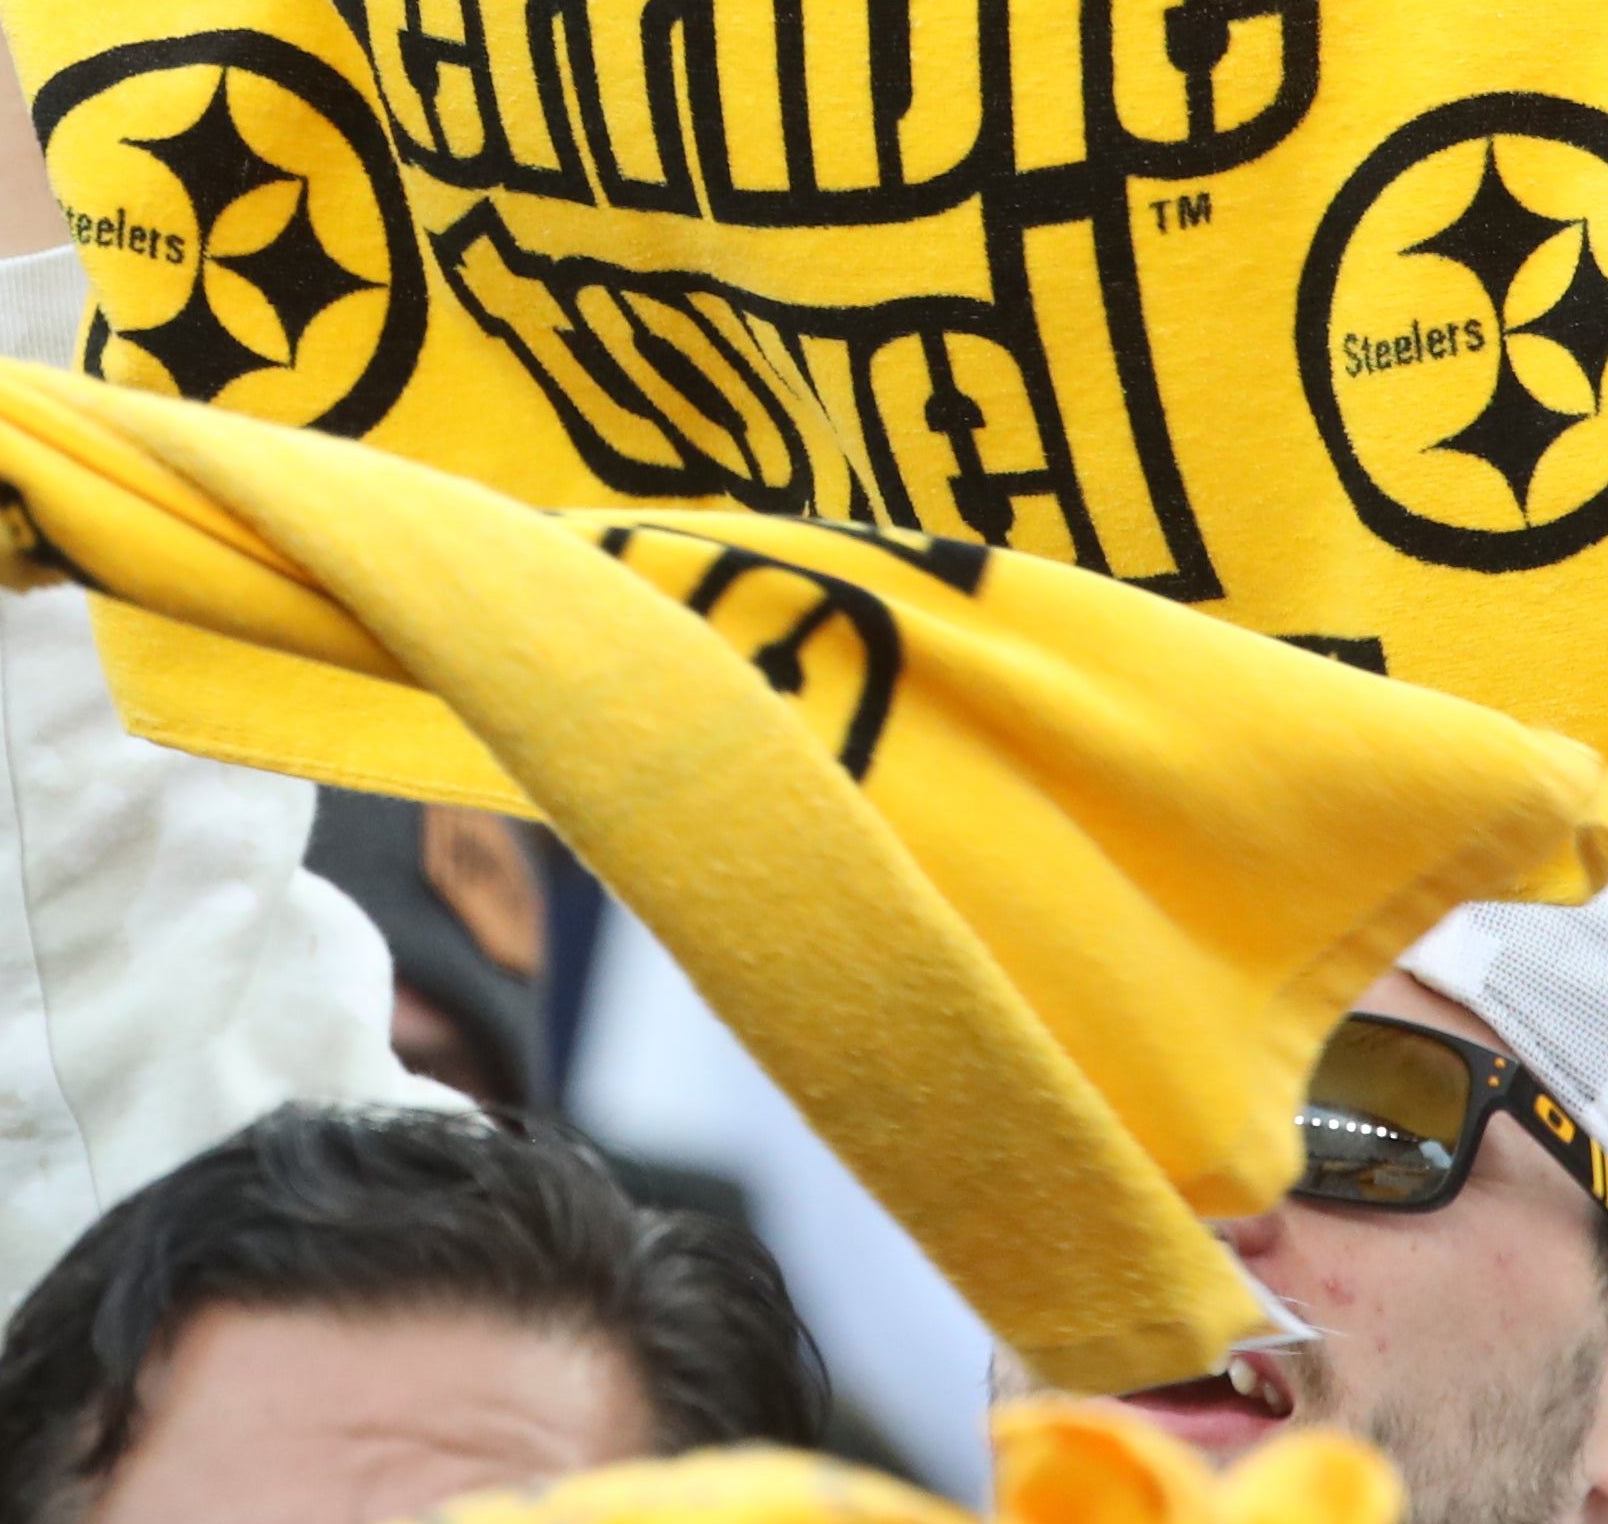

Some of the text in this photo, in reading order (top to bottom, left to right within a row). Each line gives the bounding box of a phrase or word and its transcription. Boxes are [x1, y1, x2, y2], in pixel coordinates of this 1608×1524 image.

[57, 199, 185, 265] teelers
[1149, 192, 1212, 234] TM
[1342, 318, 1487, 378] Steelers
